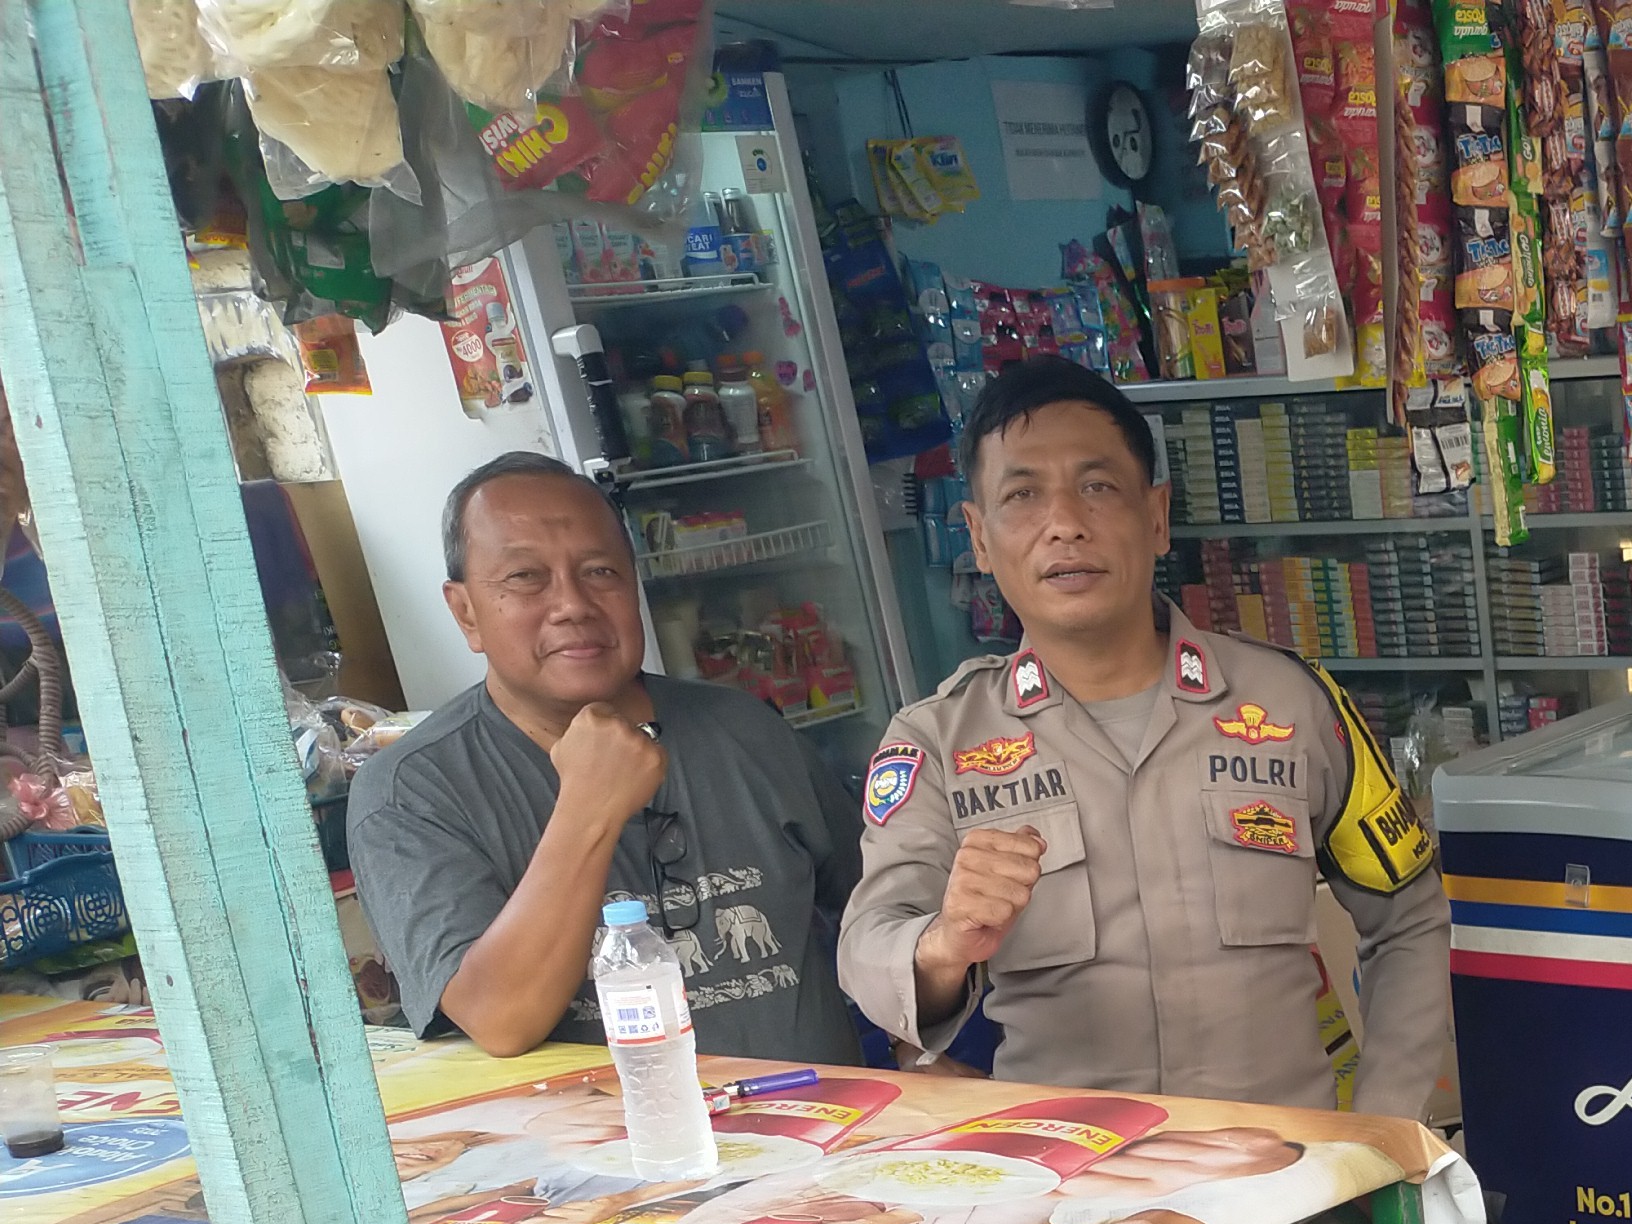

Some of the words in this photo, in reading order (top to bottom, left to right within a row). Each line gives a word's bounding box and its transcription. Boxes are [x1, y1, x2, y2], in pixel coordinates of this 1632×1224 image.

[1454, 25, 1488, 38] garuda
[1344, 106, 1376, 118] aruda
[497, 103, 569, 178] CHIKI
[929, 152, 959, 167] Klin
[687, 233, 713, 244] CARI
[462, 339, 482, 357] 4000
[1538, 407, 1553, 464] Lemonia
[1209, 755, 1297, 788] POLRI
[952, 768, 1067, 819] BAKTIAR
[1250, 833, 1285, 845] SNIPER
[744, 1102, 852, 1121] ENERG
[78, 1135, 155, 1151] Choice
[969, 1121, 1113, 1147] ENERGEN
[1576, 1186, 1632, 1218] No.1
